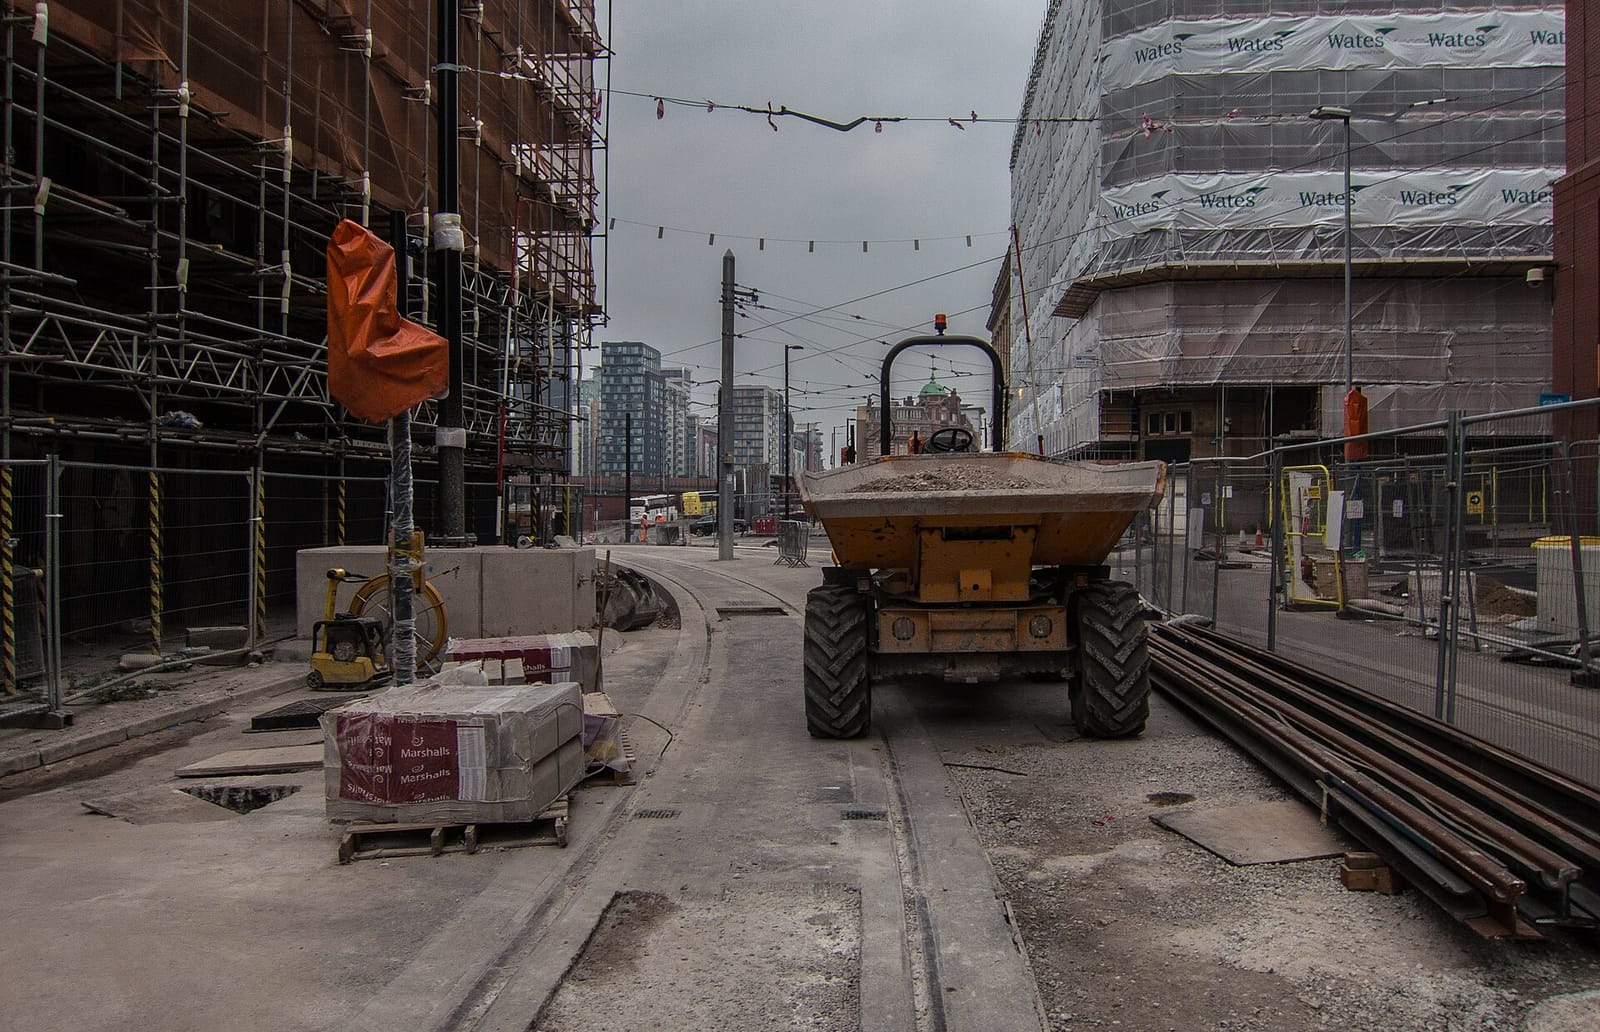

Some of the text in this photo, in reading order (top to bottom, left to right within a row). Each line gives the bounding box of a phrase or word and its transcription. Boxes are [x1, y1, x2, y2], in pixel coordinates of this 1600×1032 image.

[1228, 37, 1283, 52] Wates
[1327, 33, 1384, 48] Wates
[1429, 32, 1485, 47] Wates
[1135, 40, 1182, 64] Wates
[1199, 194, 1255, 209] Wates
[1299, 191, 1356, 207] Wates
[1400, 190, 1457, 205] Wates
[1112, 199, 1160, 219] Wates
[400, 746, 450, 758] Marshalls
[400, 769, 451, 784] Marshalls
